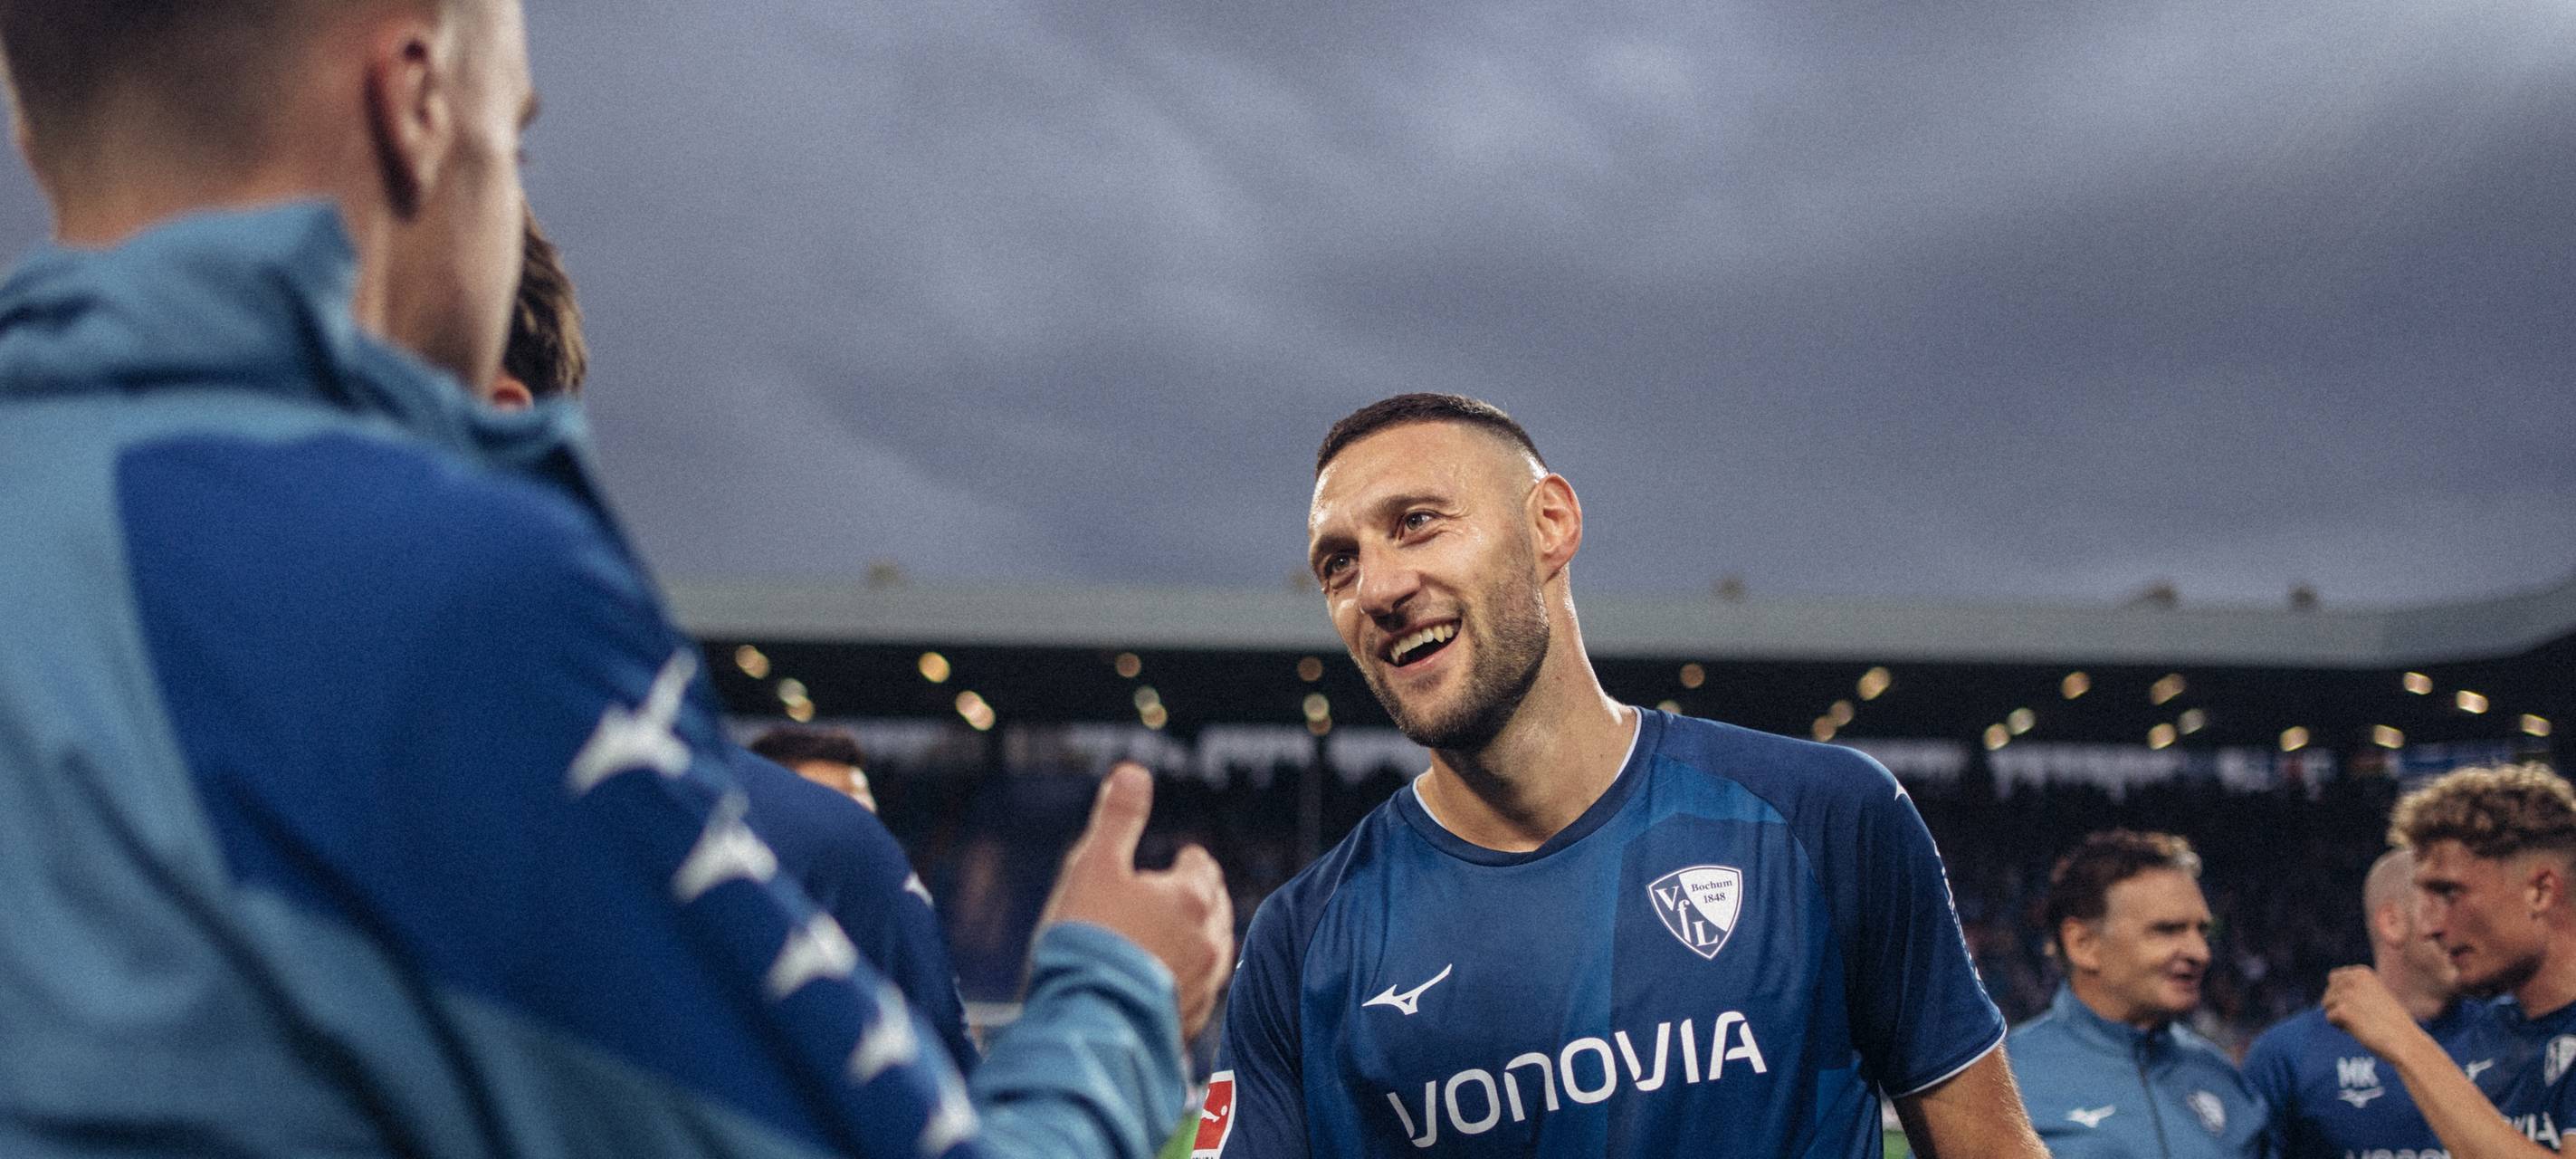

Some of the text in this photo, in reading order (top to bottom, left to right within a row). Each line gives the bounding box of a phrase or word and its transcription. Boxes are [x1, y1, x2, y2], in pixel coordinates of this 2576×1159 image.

[1691, 879, 1733, 892] Bochum
[1703, 892, 1726, 904] 1848
[1655, 886, 1718, 946] VfL
